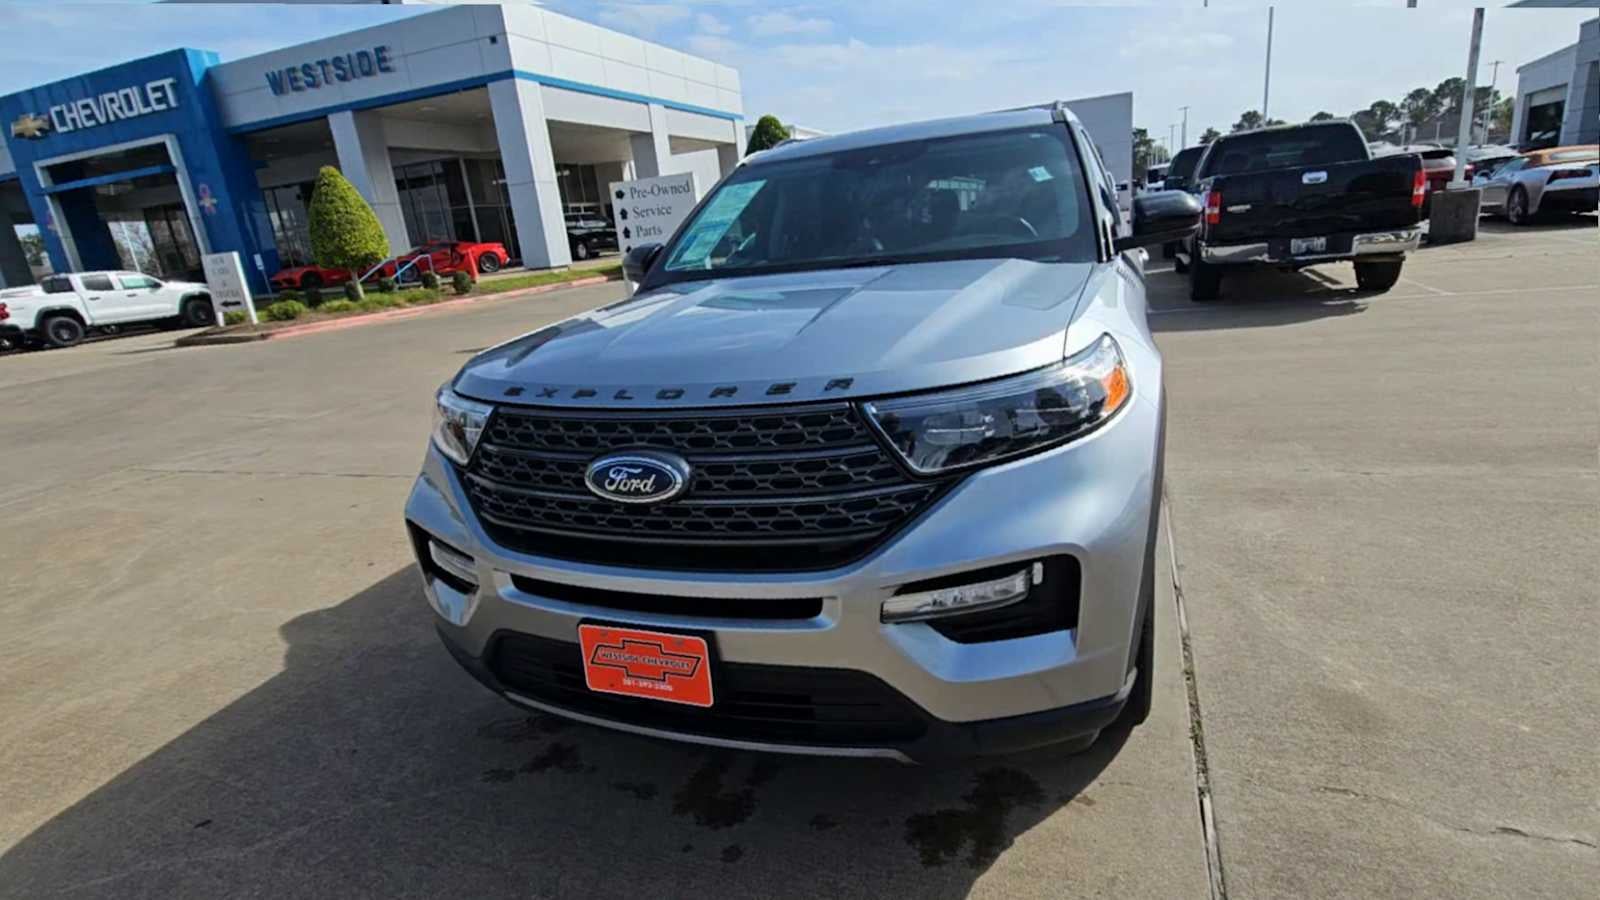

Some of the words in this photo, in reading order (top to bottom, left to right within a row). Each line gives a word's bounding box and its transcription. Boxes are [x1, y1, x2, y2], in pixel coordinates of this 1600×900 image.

[265, 44, 394, 97] WESTSIDE
[48, 77, 179, 135] CHEVROLET
[629, 179, 690, 200] Pre-Owned
[632, 203, 673, 219] Service
[635, 225, 663, 239] Parts
[503, 377, 854, 400] EXPLORER
[604, 465, 656, 494] Ford
